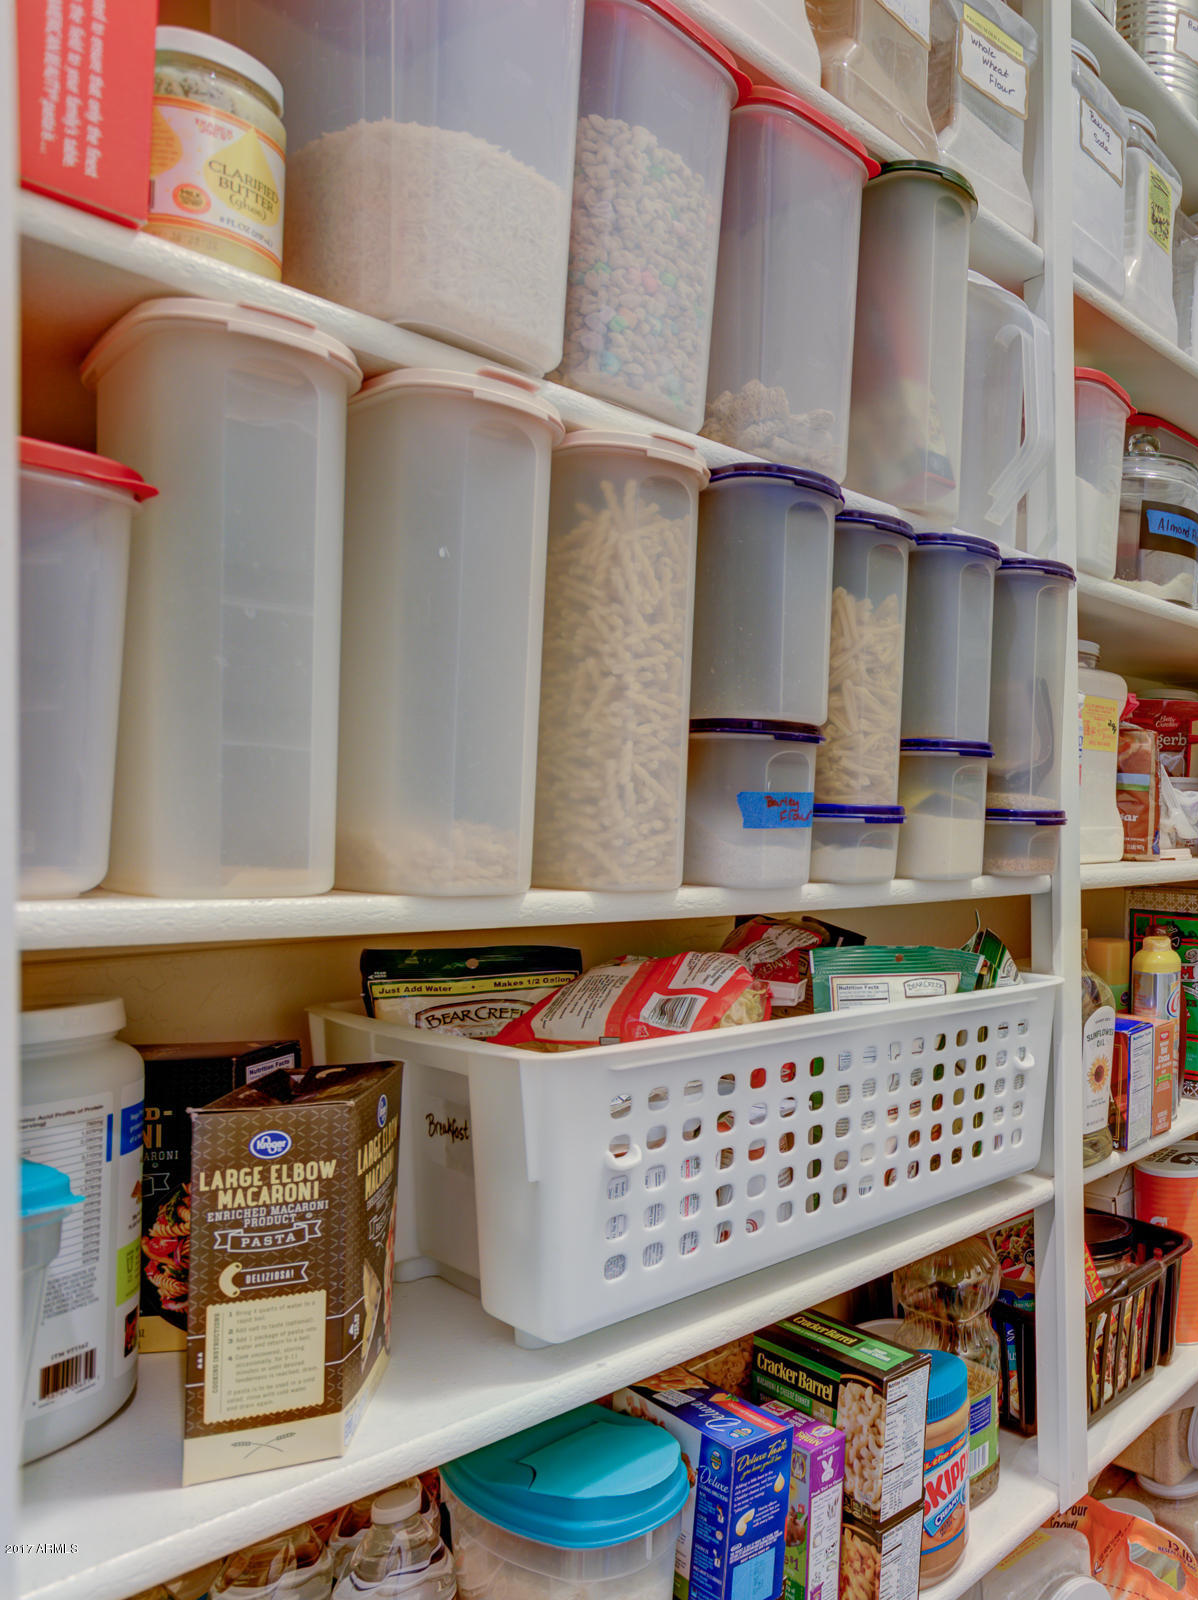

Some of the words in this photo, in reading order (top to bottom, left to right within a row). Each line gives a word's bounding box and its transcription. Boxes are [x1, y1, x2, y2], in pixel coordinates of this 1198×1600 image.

[208, 160, 280, 205] CLARIFIED
[218, 176, 275, 214] BUTTER
[1157, 516, 1192, 539] Almond
[764, 795, 800, 811] Barley
[379, 985, 400, 994] Just
[404, 985, 420, 993] Add
[423, 984, 453, 993] Water
[493, 979, 523, 988] Makes
[526, 978, 540, 986] 1/2
[542, 976, 572, 985] Gallon
[424, 1008, 474, 1029] BEAR
[249, 1064, 274, 1076] Nutrition
[275, 1059, 290, 1069] Facts
[425, 1113, 471, 1143] Breakfast
[256, 1135, 287, 1155] Kroger
[357, 1131, 382, 1176] LARGE
[199, 1166, 263, 1191] LARGE
[270, 1159, 337, 1184] ELBOW
[217, 1181, 320, 1210] MACARONI
[206, 1206, 267, 1223] ENRICHED
[270, 1200, 329, 1215] MACARONI
[244, 1213, 297, 1228] PRODUCT
[240, 1232, 296, 1248] PASTA
[245, 1269, 295, 1284] DELIZIOSA!
[793, 1315, 827, 1336] Cracker
[825, 1327, 858, 1345] Barrel
[756, 1352, 799, 1385] Cracker
[798, 1370, 833, 1402] Barrel
[736, 1449, 767, 1472] Deluxe
[699, 1465, 731, 1494] Deluxe
[924, 1452, 968, 1516] KIPP
